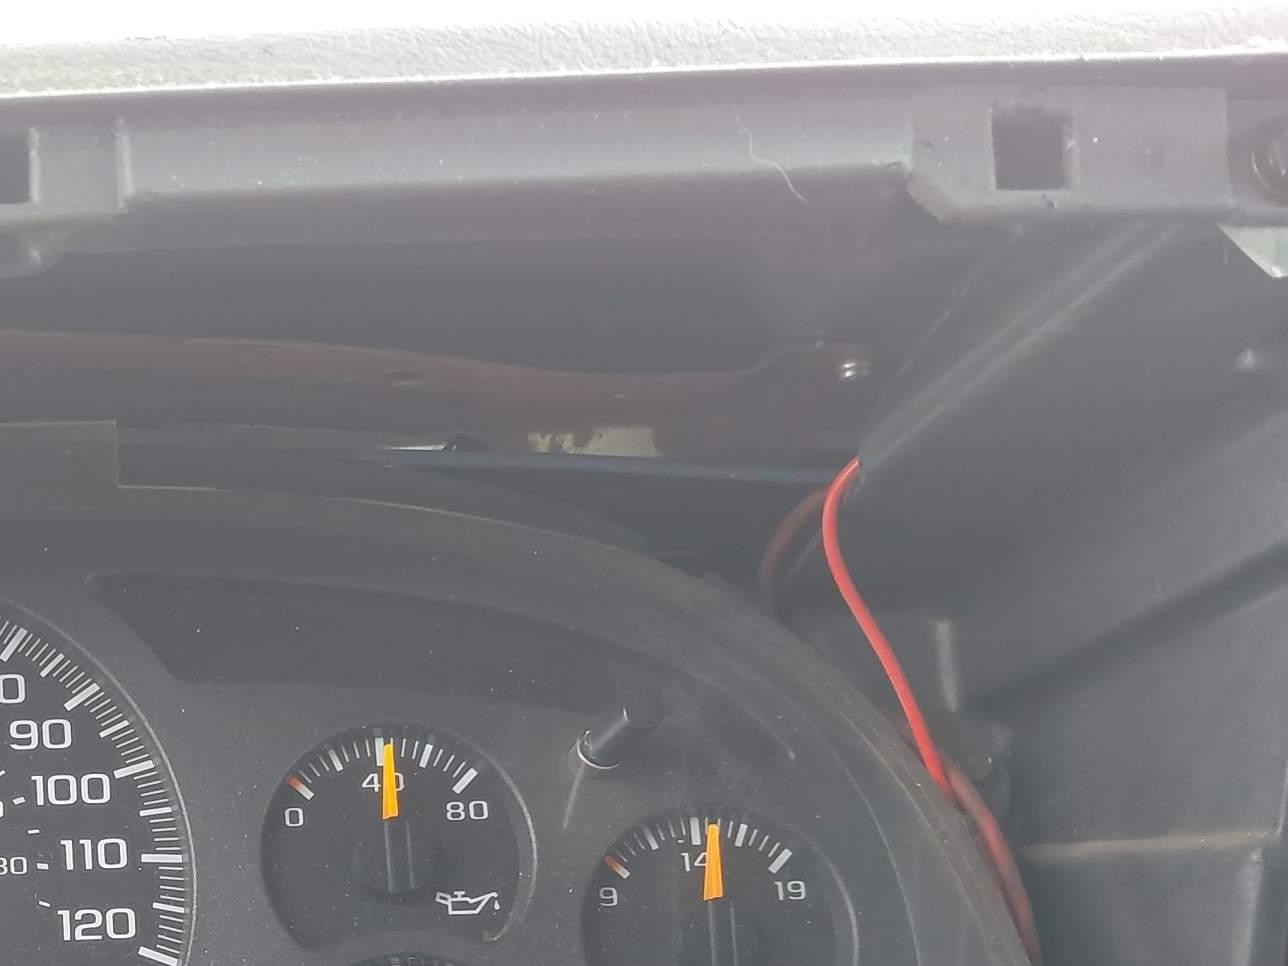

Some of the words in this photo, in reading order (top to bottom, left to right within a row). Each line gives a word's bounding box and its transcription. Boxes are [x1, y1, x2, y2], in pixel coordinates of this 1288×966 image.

[9, 718, 72, 750] 90
[31, 773, 111, 806] 100
[284, 807, 304, 827] 0
[446, 800, 489, 821] 80
[60, 838, 128, 871] 110
[599, 887, 618, 907] 9
[774, 880, 806, 901] 19
[57, 908, 136, 941] 120
